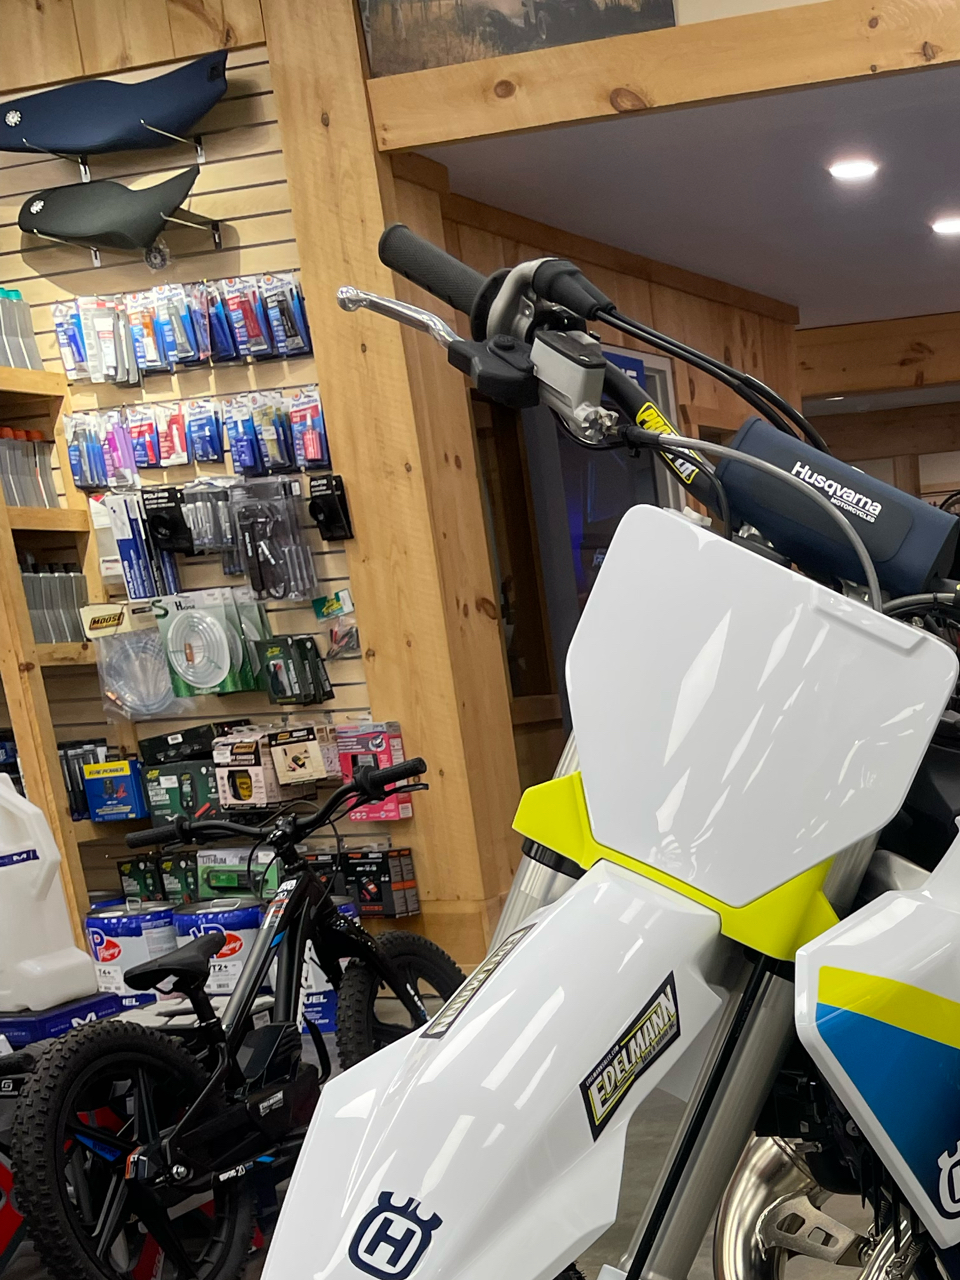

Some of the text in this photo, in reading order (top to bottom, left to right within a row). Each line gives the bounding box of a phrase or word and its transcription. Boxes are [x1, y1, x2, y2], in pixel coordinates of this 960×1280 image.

[791, 460, 882, 516] Husqvarna
[830, 497, 876, 523] MOTORCYCLES
[586, 1044, 620, 1086] EDELMANNSALES.COM
[588, 984, 676, 1126] EDELMANN
